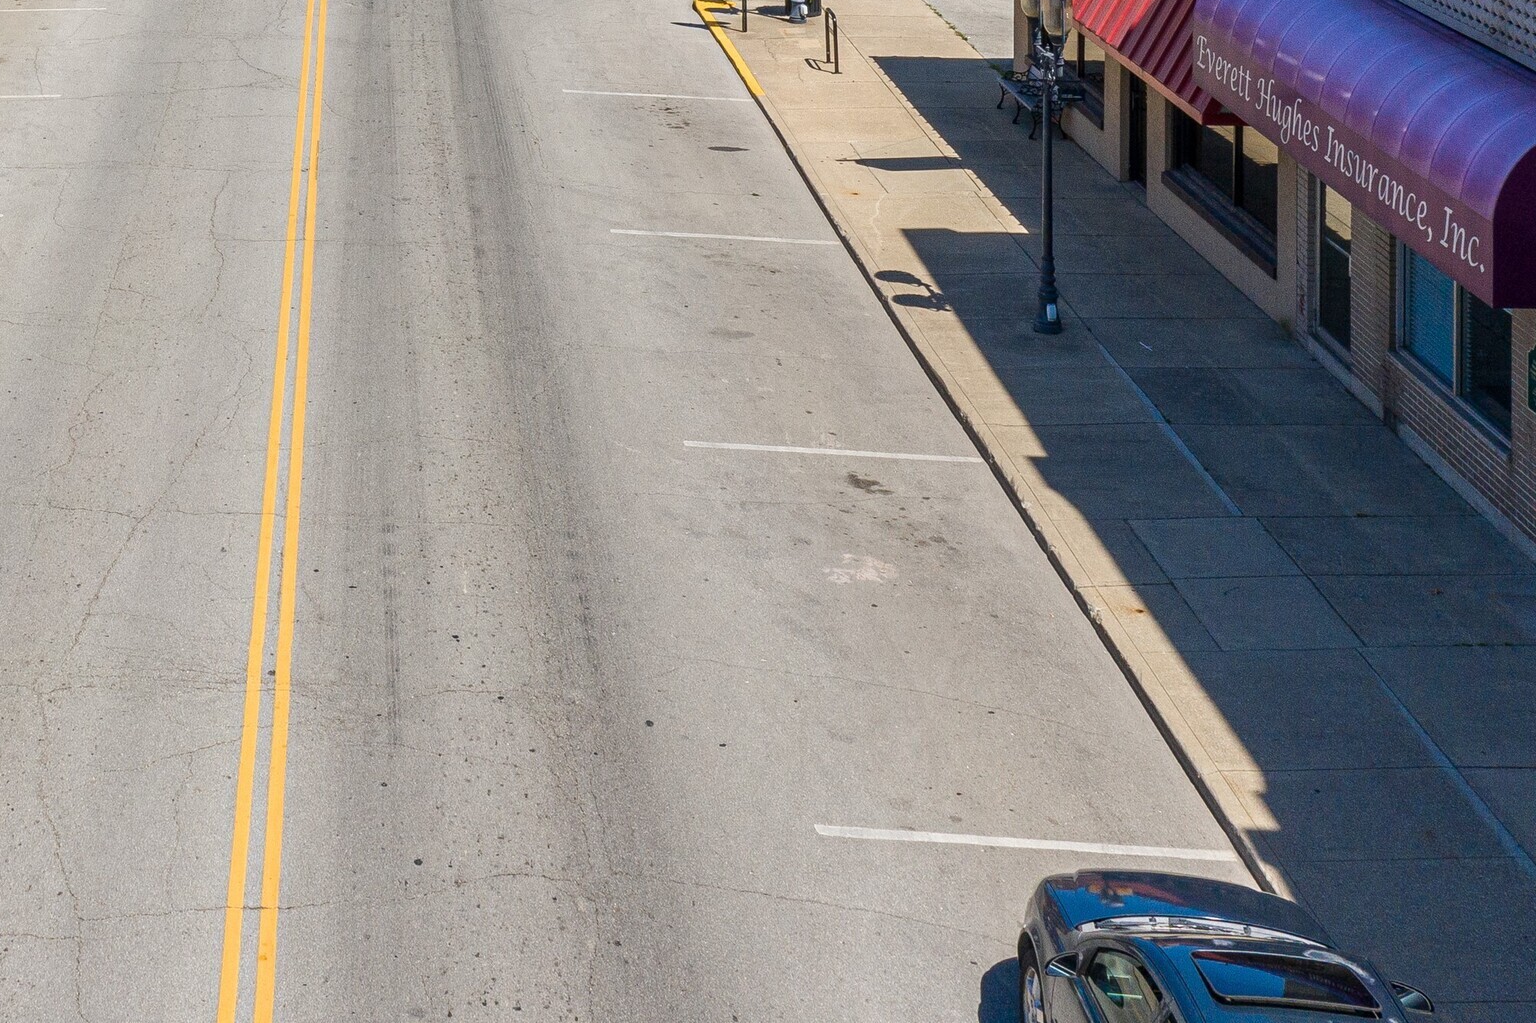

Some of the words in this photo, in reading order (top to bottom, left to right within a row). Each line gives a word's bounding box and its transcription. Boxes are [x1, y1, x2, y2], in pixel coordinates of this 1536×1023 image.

[1197, 35, 1252, 102] Everett
[1256, 78, 1320, 152] Hughes
[1324, 126, 1433, 242] Insurance,
[1440, 206, 1485, 273] Inc.
